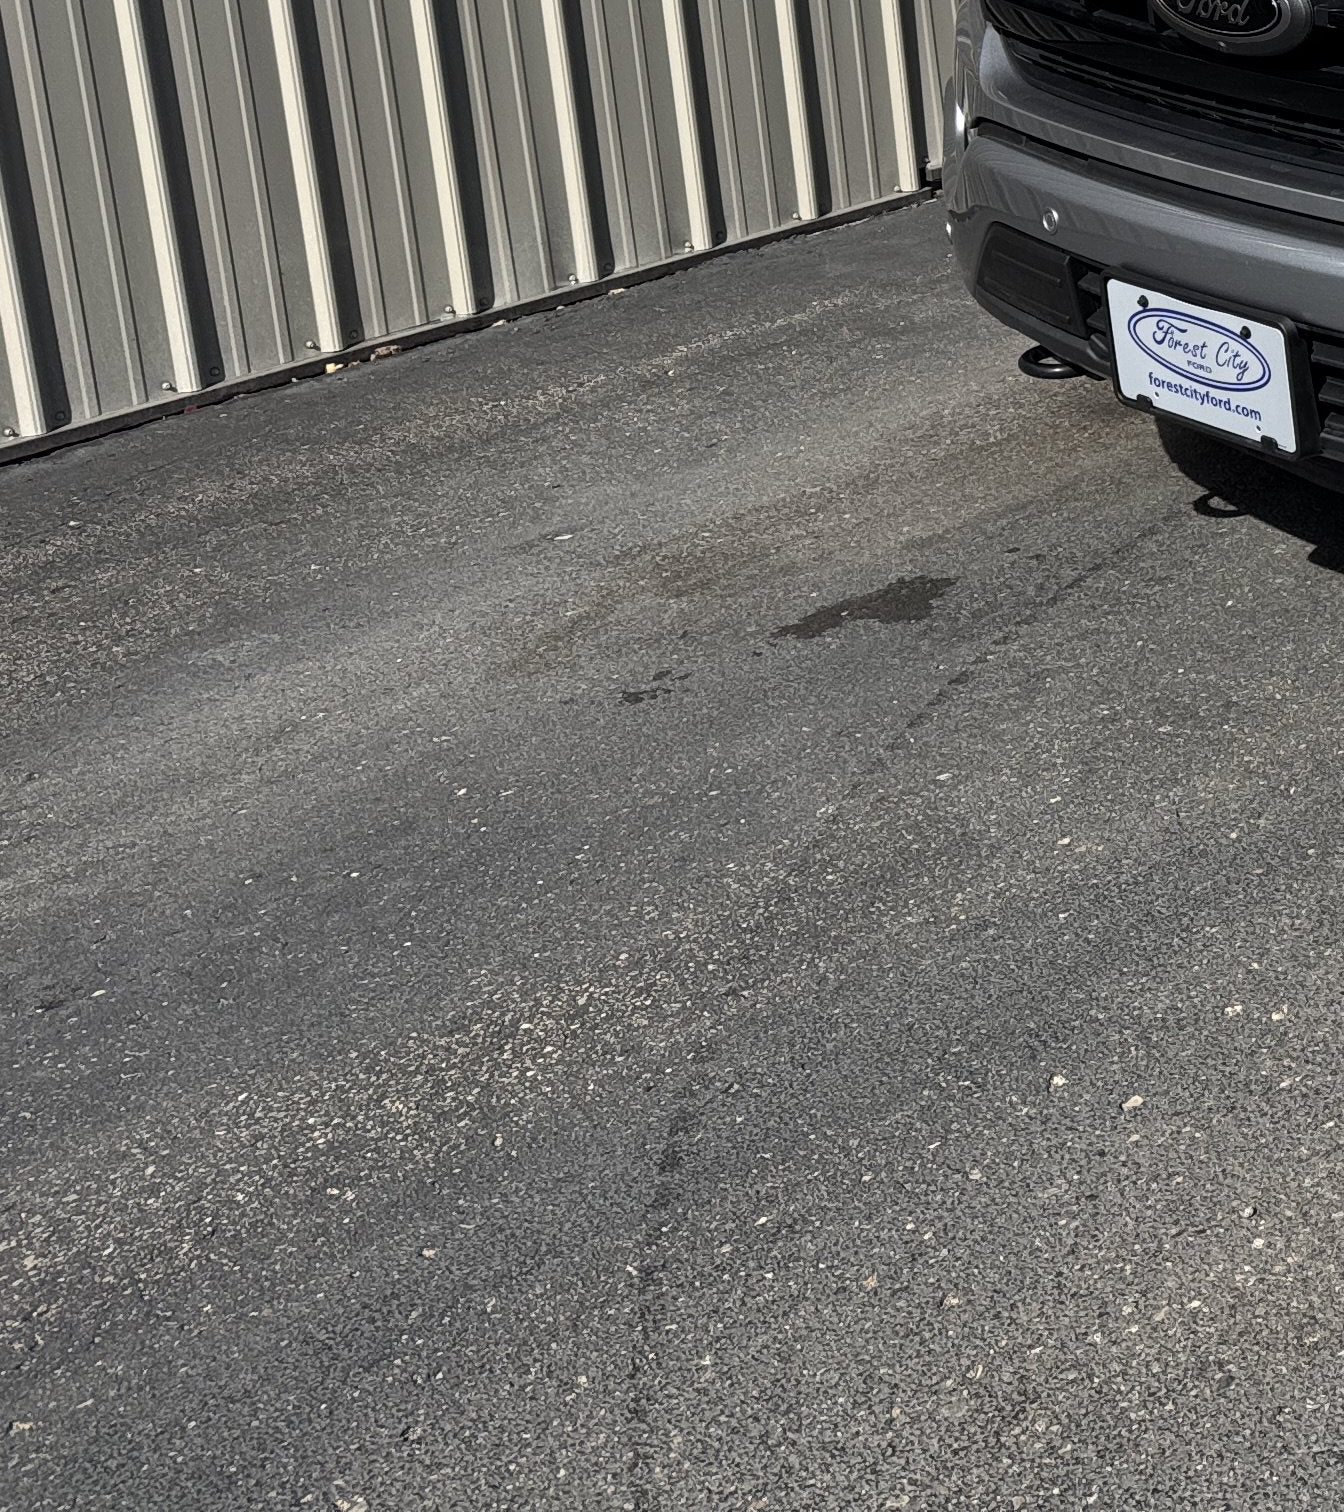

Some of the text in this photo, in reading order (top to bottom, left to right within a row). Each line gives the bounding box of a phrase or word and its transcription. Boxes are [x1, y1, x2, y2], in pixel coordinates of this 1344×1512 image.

[1152, 319, 1251, 381] Forest City
[1186, 359, 1213, 374] FORD
[1148, 372, 1262, 421] forestcityford.com
